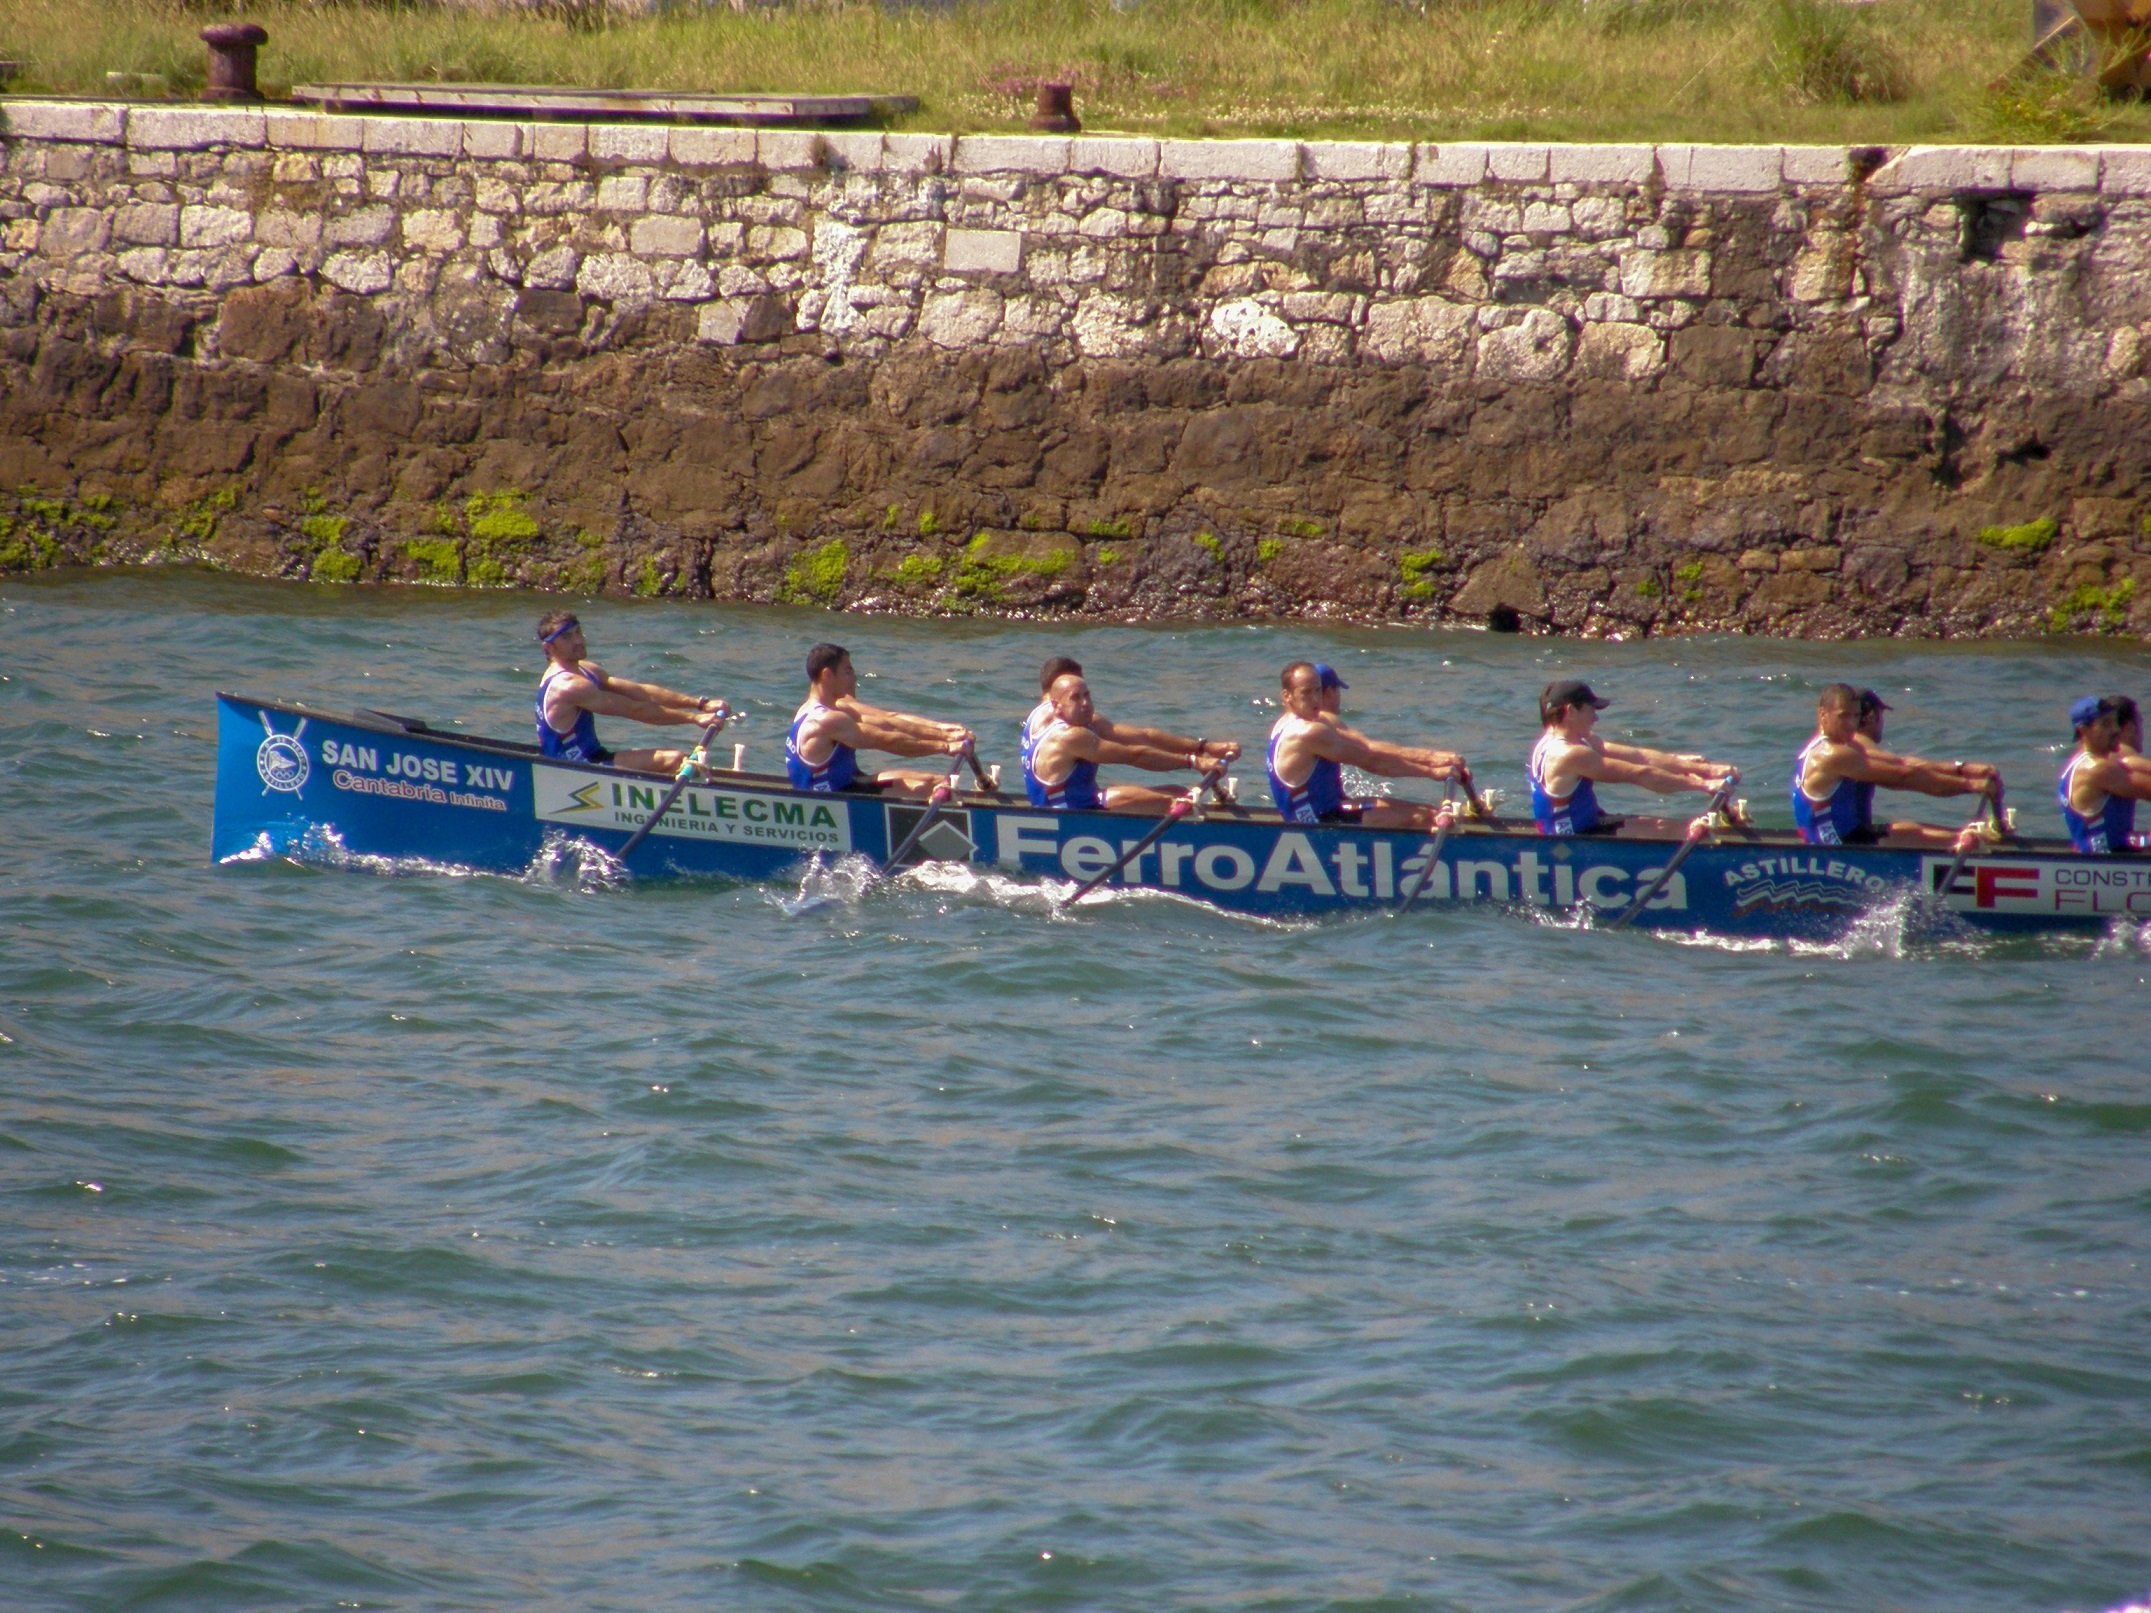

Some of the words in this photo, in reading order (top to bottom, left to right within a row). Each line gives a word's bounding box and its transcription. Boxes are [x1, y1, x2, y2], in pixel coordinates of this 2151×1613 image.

[322, 739, 377, 772] SAN
[385, 752, 458, 783] JOSE
[465, 763, 513, 791] XIV
[333, 768, 448, 804] Cantabria
[449, 791, 507, 811] Infinita
[615, 811, 719, 833] INGNIERIA
[725, 823, 736, 835] Y
[743, 825, 840, 844] SERVICIOS
[995, 814, 1688, 910] FerroAtlántica
[1724, 857, 1886, 892] ASTILLERO
[2055, 868, 2151, 887] CONST
